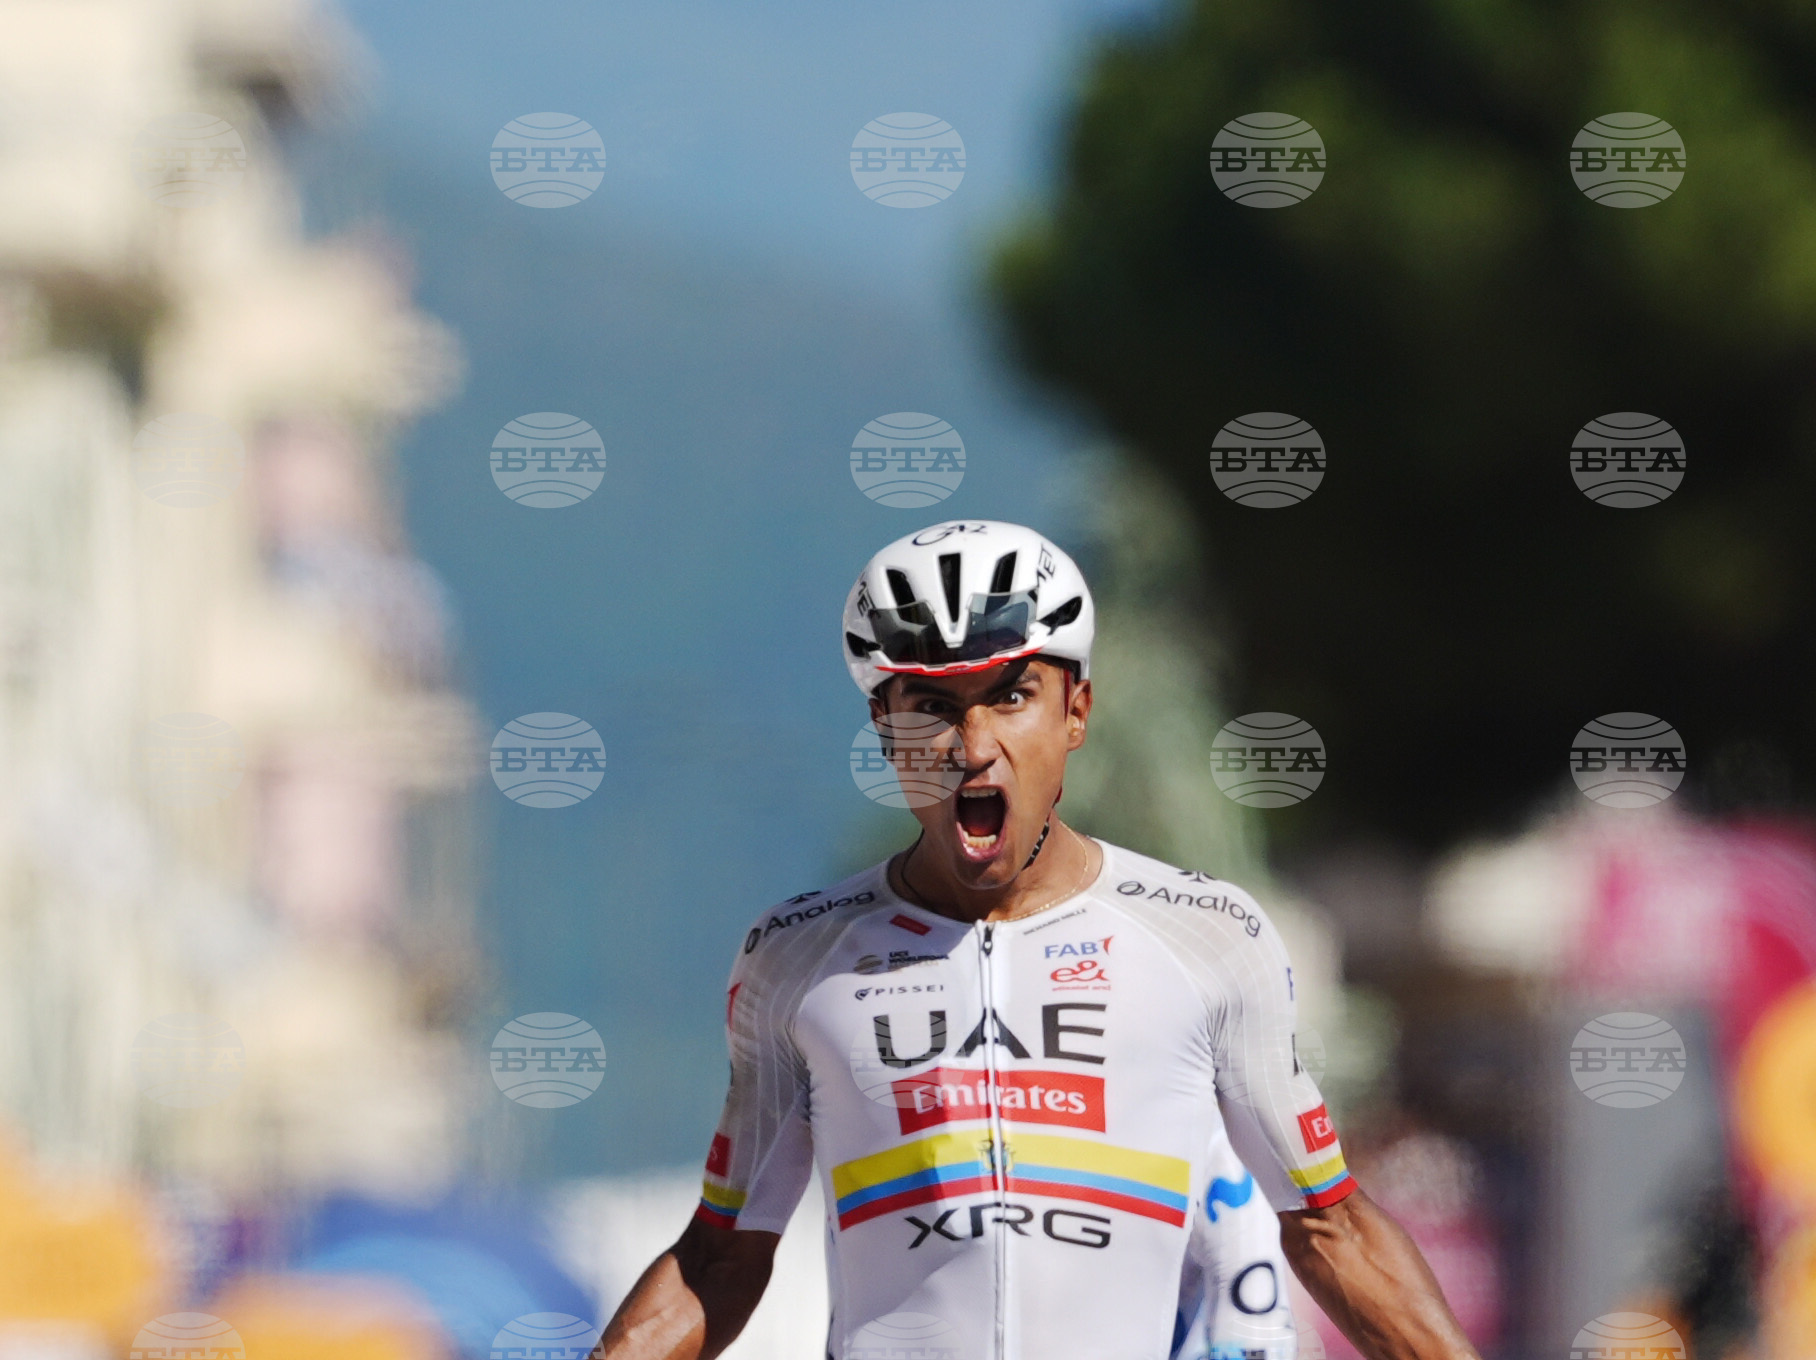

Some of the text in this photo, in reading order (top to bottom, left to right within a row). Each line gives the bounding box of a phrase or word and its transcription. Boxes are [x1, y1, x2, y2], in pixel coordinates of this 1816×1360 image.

[763, 890, 876, 938] Analog
[1148, 886, 1262, 938] Analog
[875, 984, 944, 997] PISSEI
[873, 1002, 1107, 1069] UAE
[911, 1079, 1088, 1116] Emirates
[904, 1202, 1112, 1250] XRG
